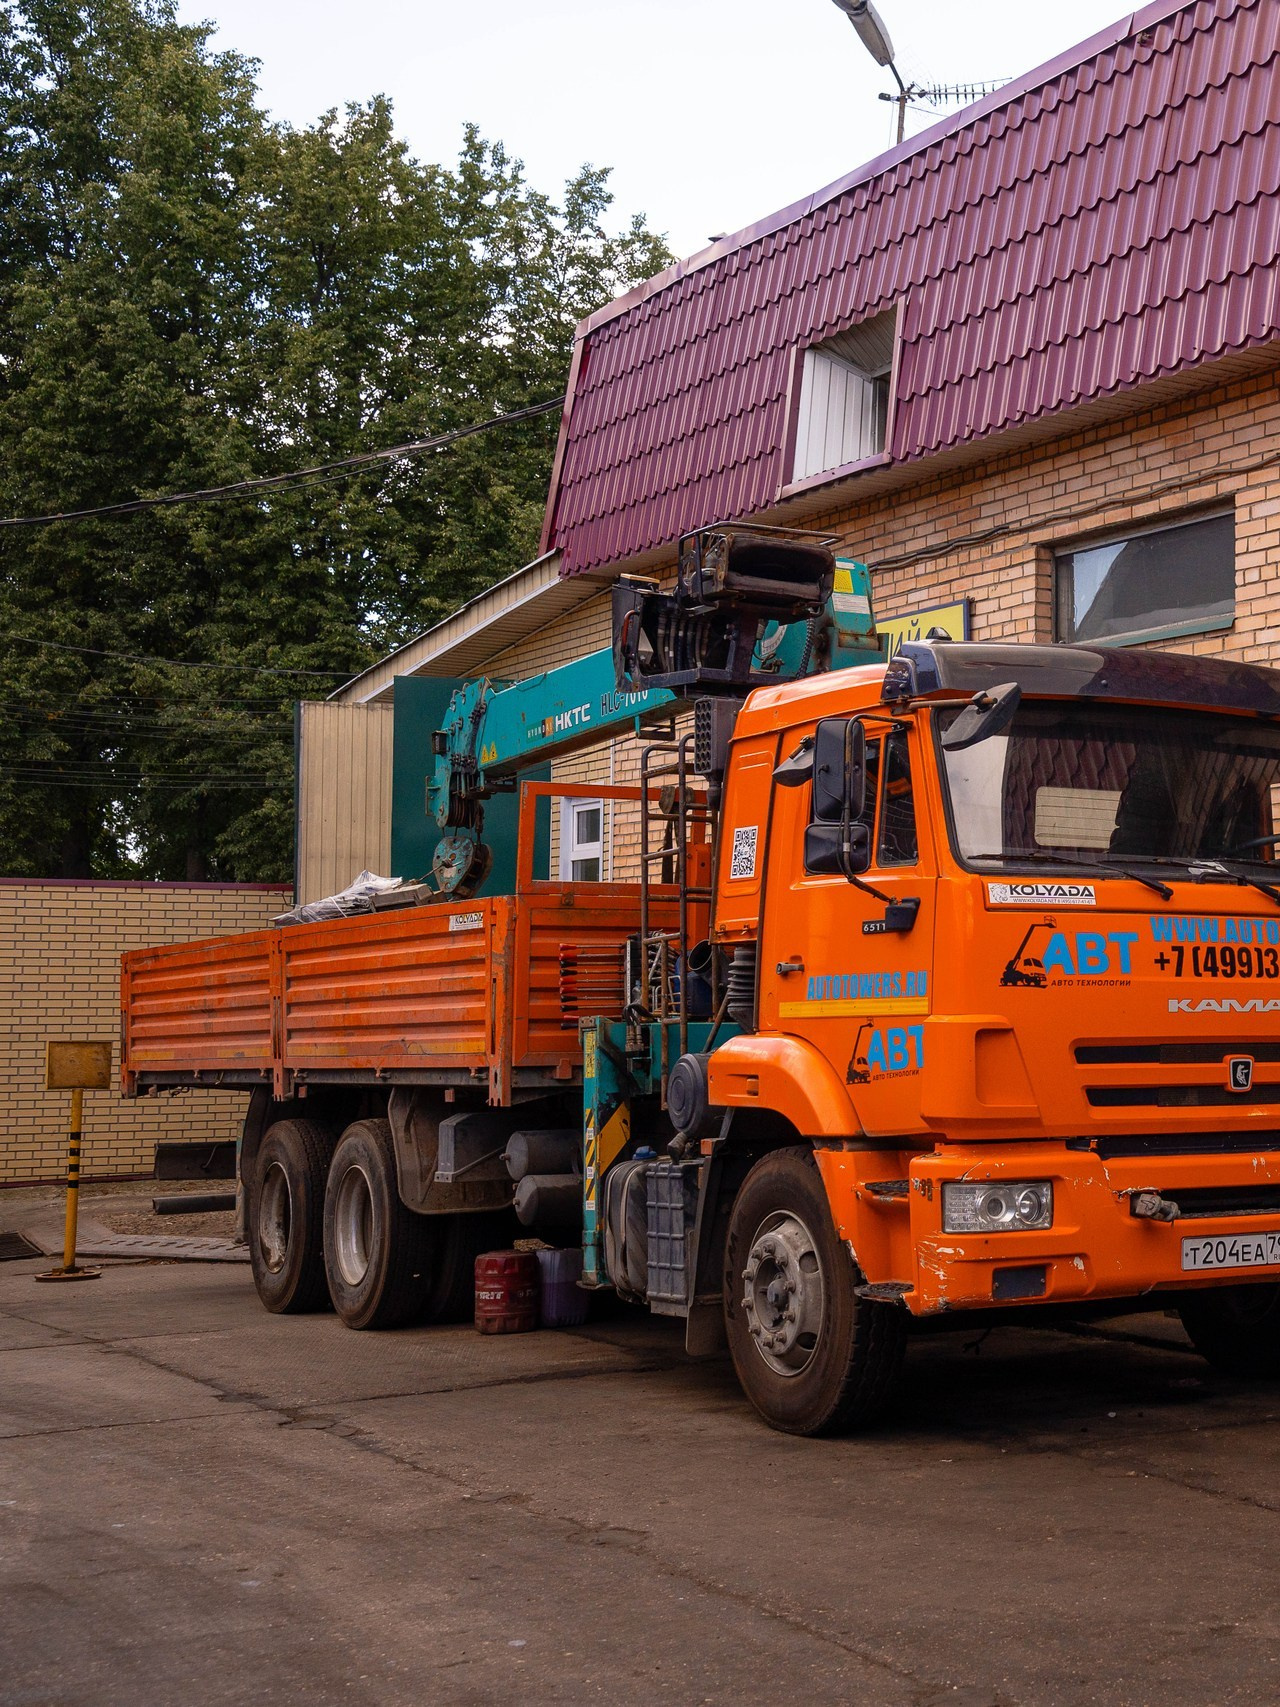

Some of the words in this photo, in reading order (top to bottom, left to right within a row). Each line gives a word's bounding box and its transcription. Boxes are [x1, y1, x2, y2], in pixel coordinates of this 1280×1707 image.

[555, 703, 591, 732] HKTC
[1009, 885, 1094, 897] KOLYADA
[1154, 946, 1184, 977] +7
[807, 971, 927, 1000] AUTOTOWERS.RU
[1051, 979, 1074, 987] АВТО
[1076, 979, 1131, 987] ТЕХНОЛОГИИ
[872, 1073, 885, 1081] АВТО
[886, 1069, 920, 1080] ТЕХНОЛОГИИ
